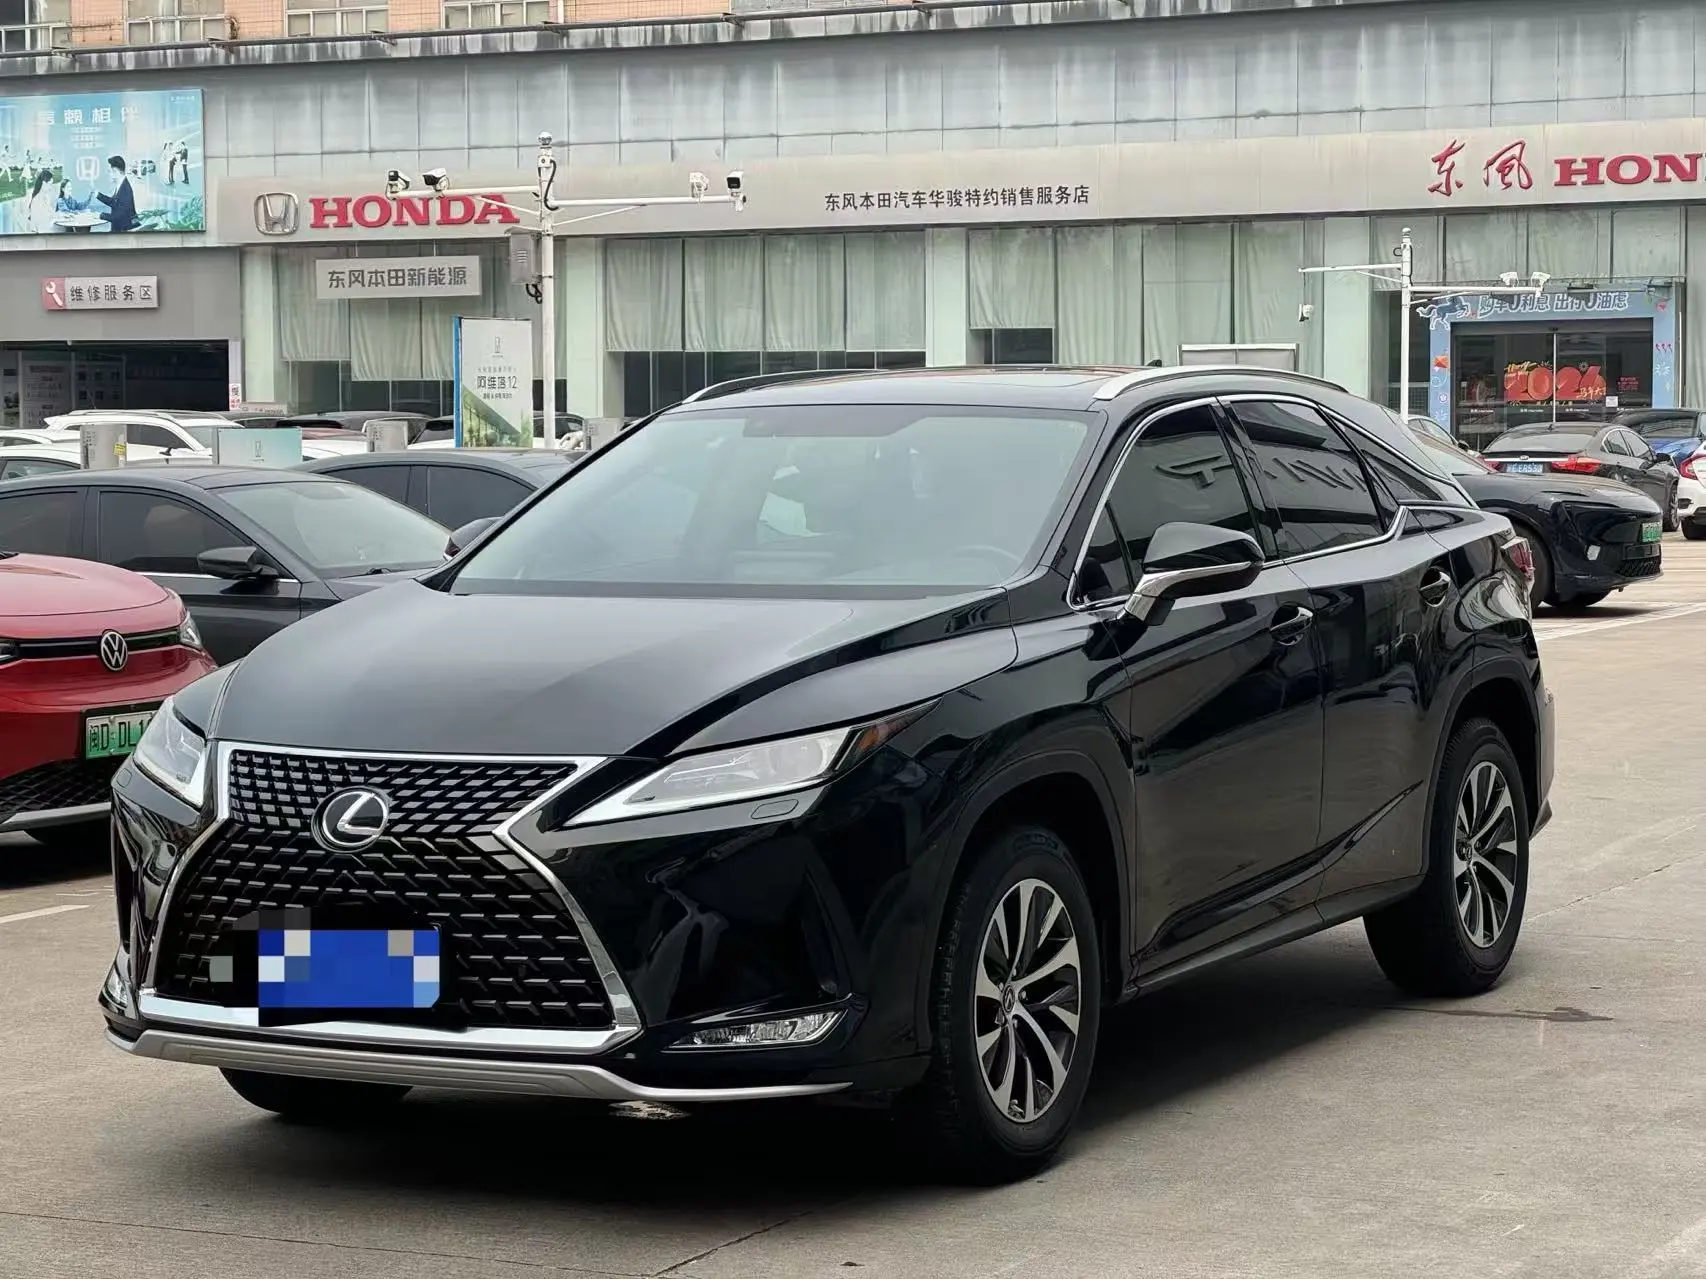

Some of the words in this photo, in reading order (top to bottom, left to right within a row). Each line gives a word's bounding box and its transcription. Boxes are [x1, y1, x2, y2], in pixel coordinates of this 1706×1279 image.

[1553, 152, 1706, 186] HON
[309, 193, 520, 229] HONDA
[823, 185, 1091, 211] 东风本田汽车华骏特约销售服务店
[327, 266, 468, 289] 东风本田新能源
[69, 284, 153, 302] 维修服务区
[1503, 365, 1607, 401] 2026
